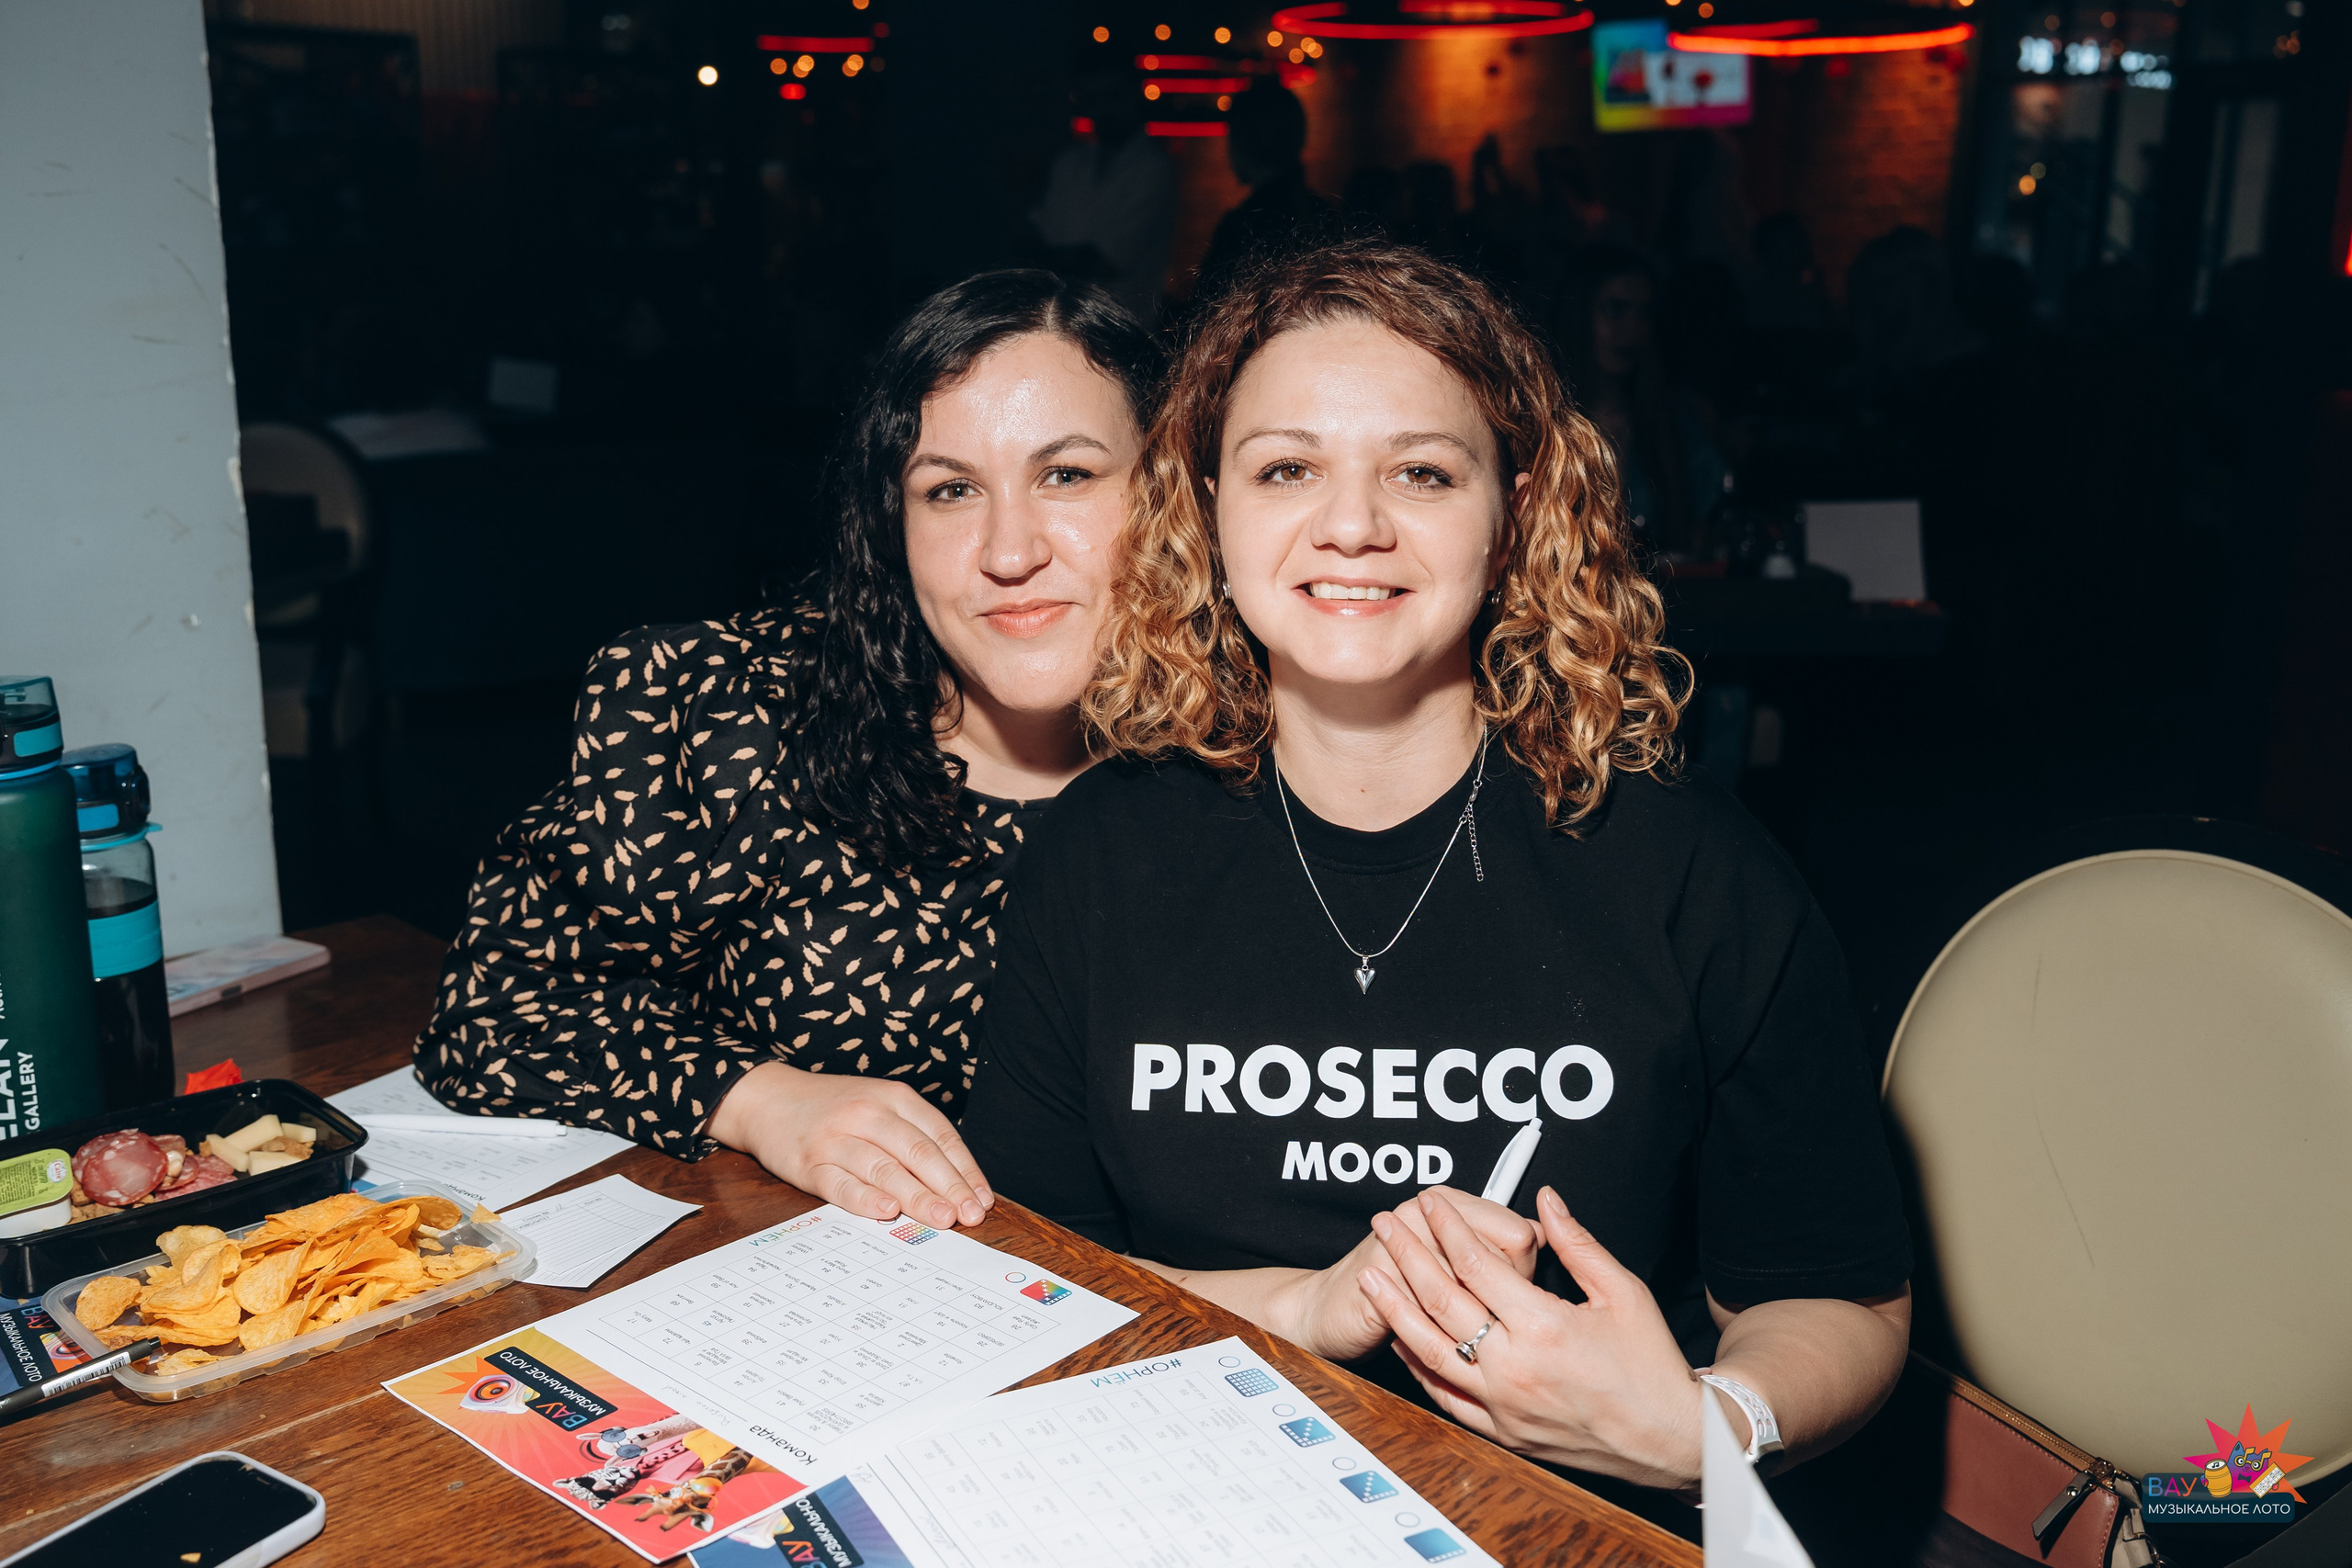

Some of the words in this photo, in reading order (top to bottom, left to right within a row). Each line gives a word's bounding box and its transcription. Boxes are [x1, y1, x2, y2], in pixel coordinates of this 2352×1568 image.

[17, 1051, 40, 1131] GALLERY
[1131, 1043, 1614, 1122] PROSECCO
[1282, 1141, 1454, 1185] MOOD
[748, 1214, 822, 1247] #ОРНЁМ
[20, 1305, 53, 1329] ВАУ
[0, 1312, 34, 1362] МУЗЫКАЛЬНОЕ
[21, 1362, 43, 1382] ЛОТО
[500, 1351, 532, 1370] ЛОТО
[525, 1366, 606, 1416] МУЗЫКАЛЬНОЕ
[1091, 1359, 1182, 1389] #ОРНЁМ
[536, 1402, 588, 1428] ВАУ
[750, 1424, 819, 1465] Команда
[796, 1495, 853, 1568] МУЗЫКАЛЬНО
